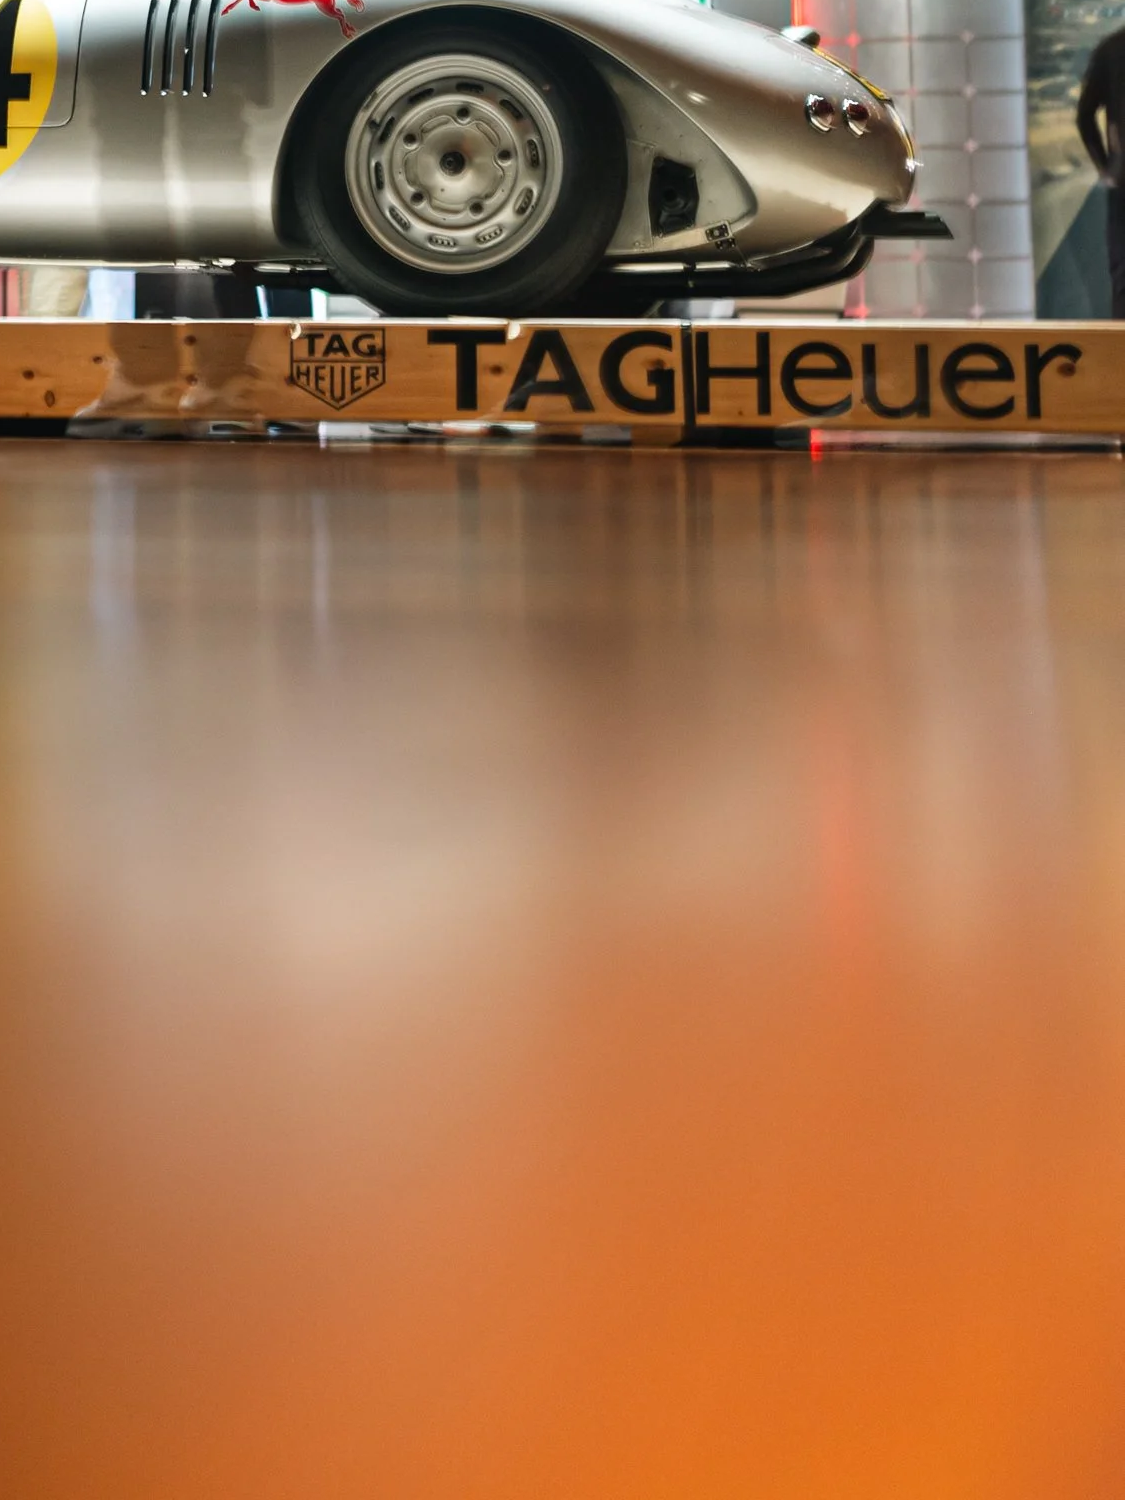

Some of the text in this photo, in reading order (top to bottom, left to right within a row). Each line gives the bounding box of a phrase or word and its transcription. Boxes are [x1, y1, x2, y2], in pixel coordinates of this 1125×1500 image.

[299, 333, 378, 358] TAG
[296, 365, 379, 403] HEUER
[427, 329, 1082, 420] TAG Heuer
